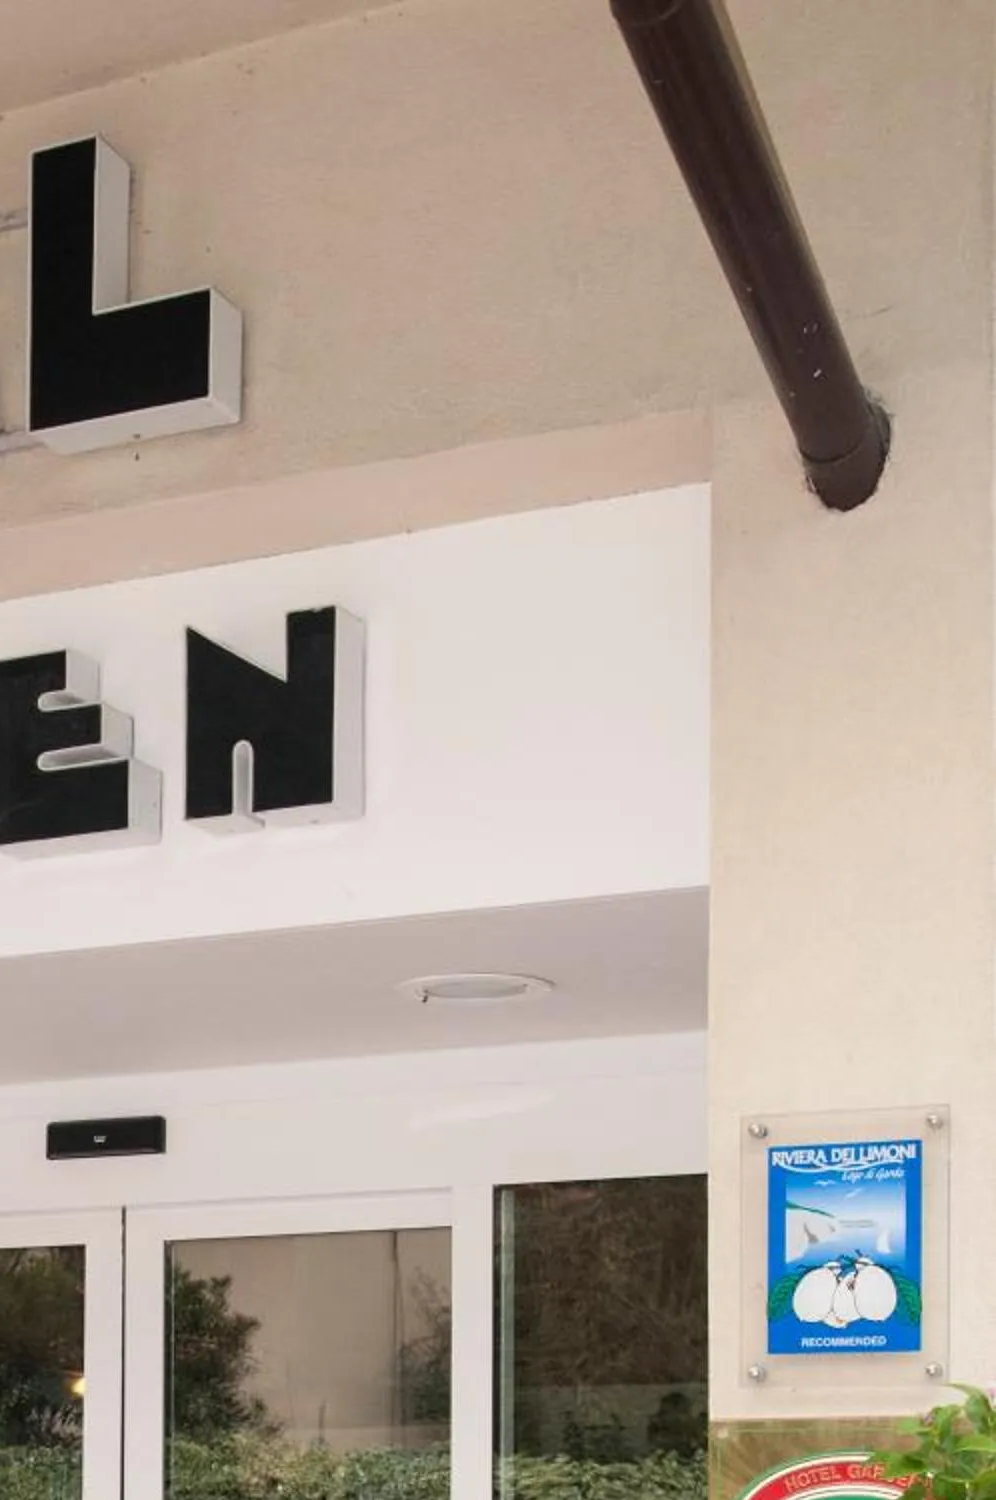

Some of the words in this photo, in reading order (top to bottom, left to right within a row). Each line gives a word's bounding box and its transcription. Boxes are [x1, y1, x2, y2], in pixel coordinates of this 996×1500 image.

[771, 1149, 828, 1166] RIVIERA
[801, 1335, 888, 1348] RECOMMENDED
[783, 1464, 841, 1493] HOTEL
